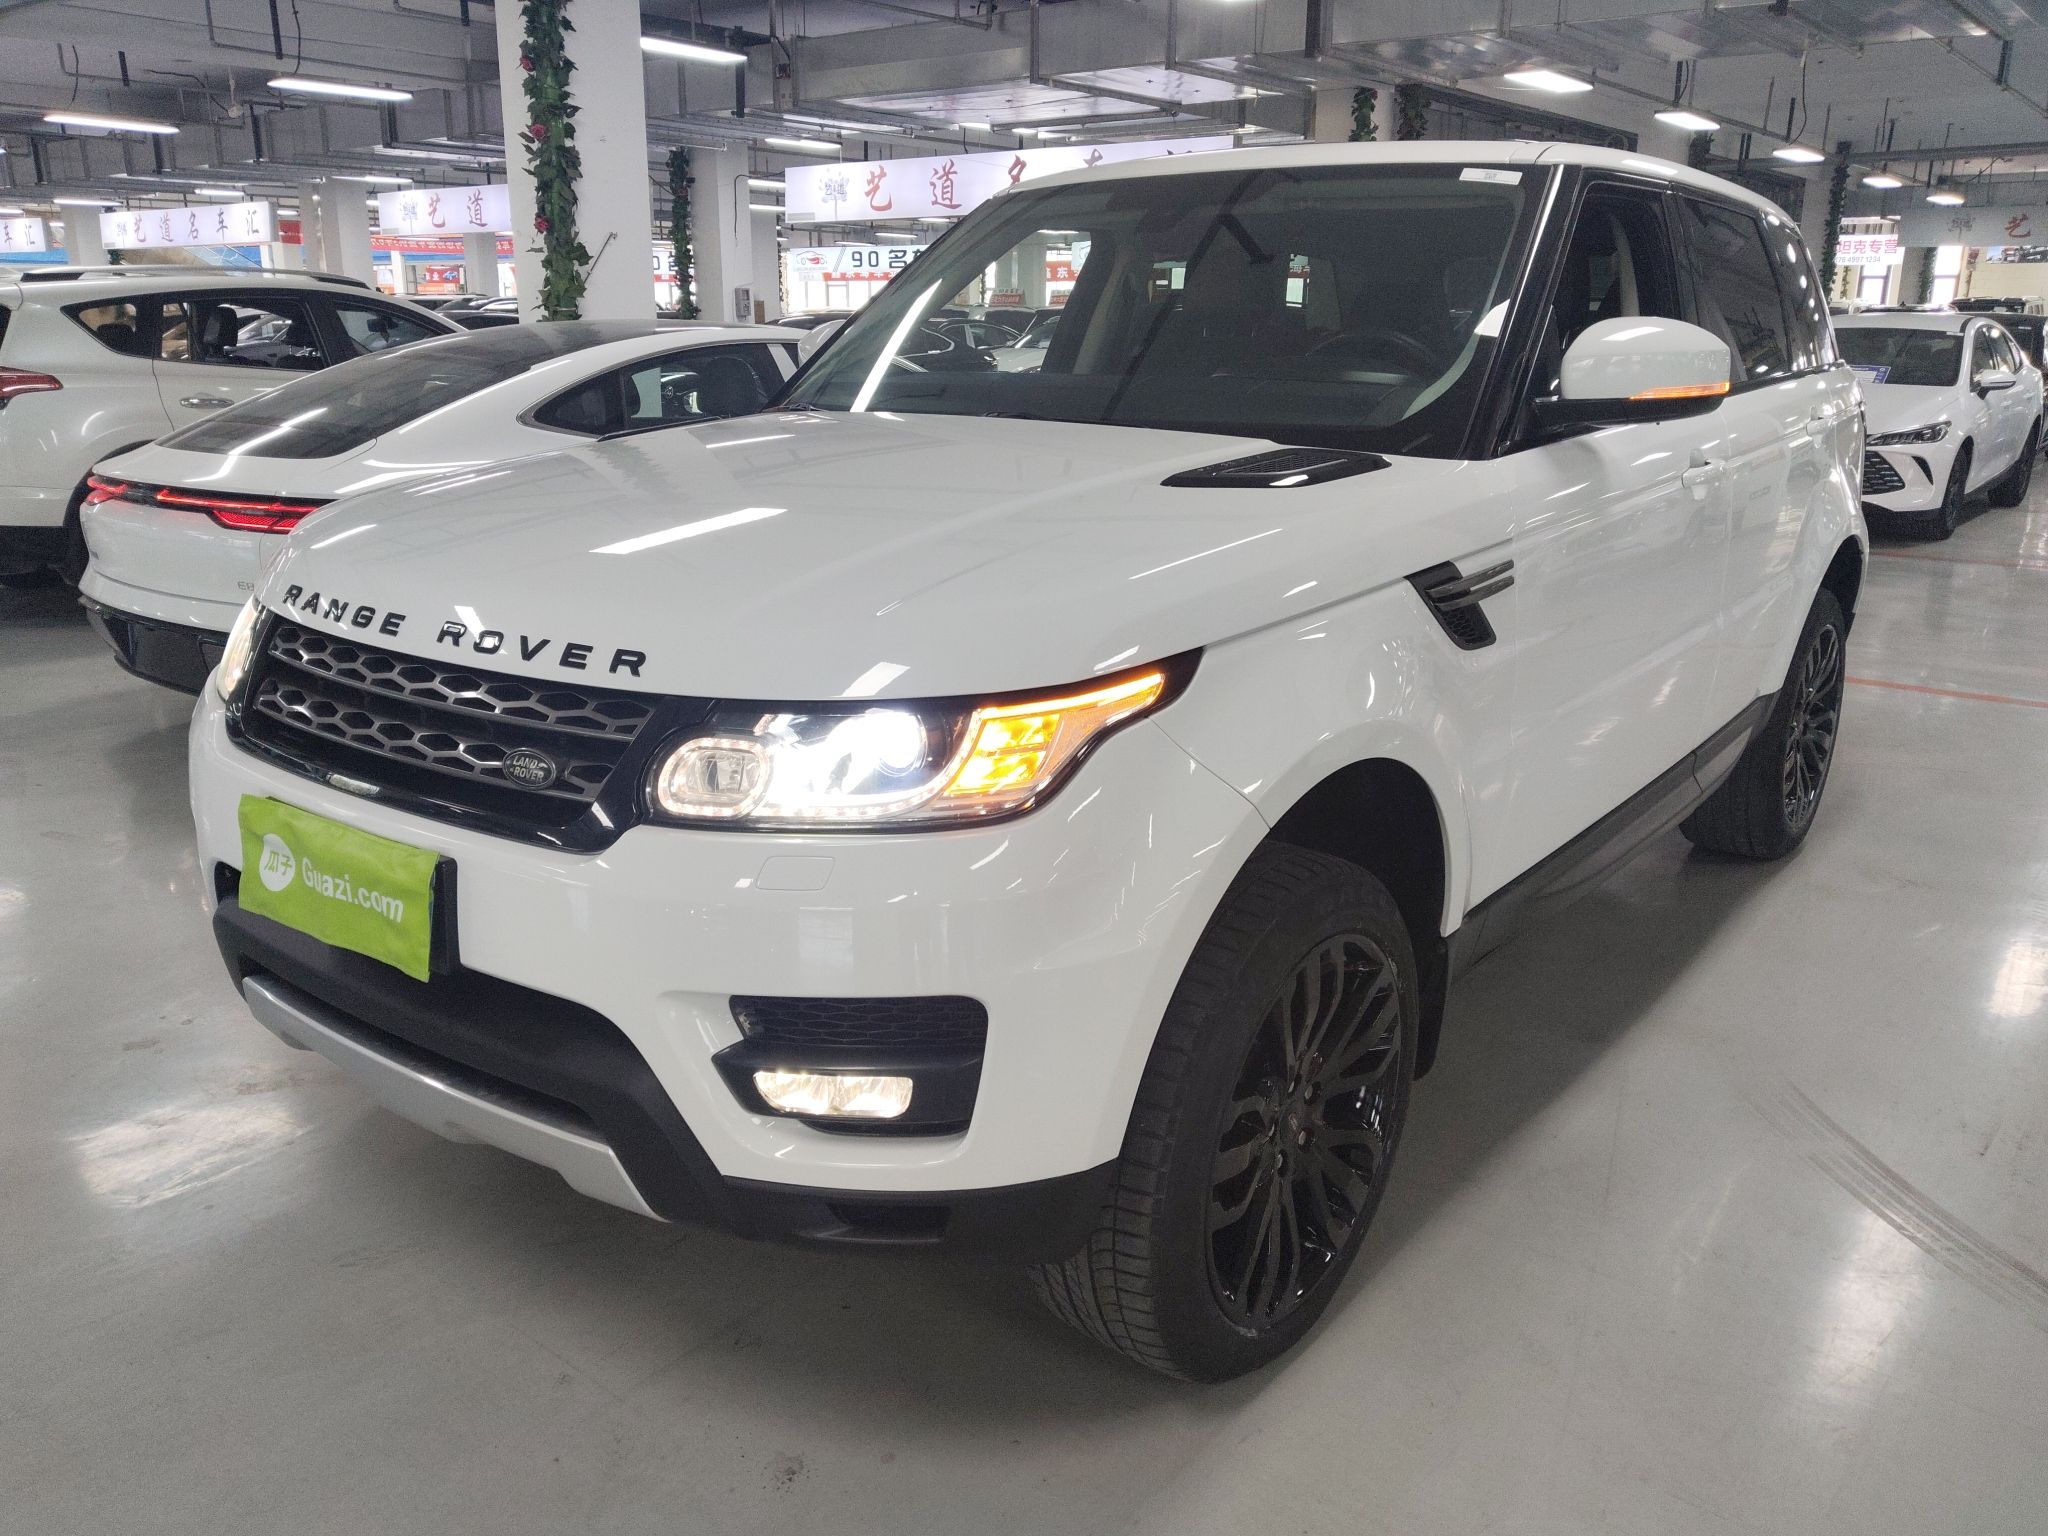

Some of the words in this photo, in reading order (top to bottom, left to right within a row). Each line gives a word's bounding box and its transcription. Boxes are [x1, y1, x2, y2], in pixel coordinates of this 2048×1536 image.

[282, 584, 406, 637] RANGE
[436, 620, 647, 678] ROVER
[512, 755, 538, 769] LAND
[513, 766, 544, 782] ROVER
[264, 850, 292, 876] 瓜子
[302, 857, 404, 923] Guazi.com
